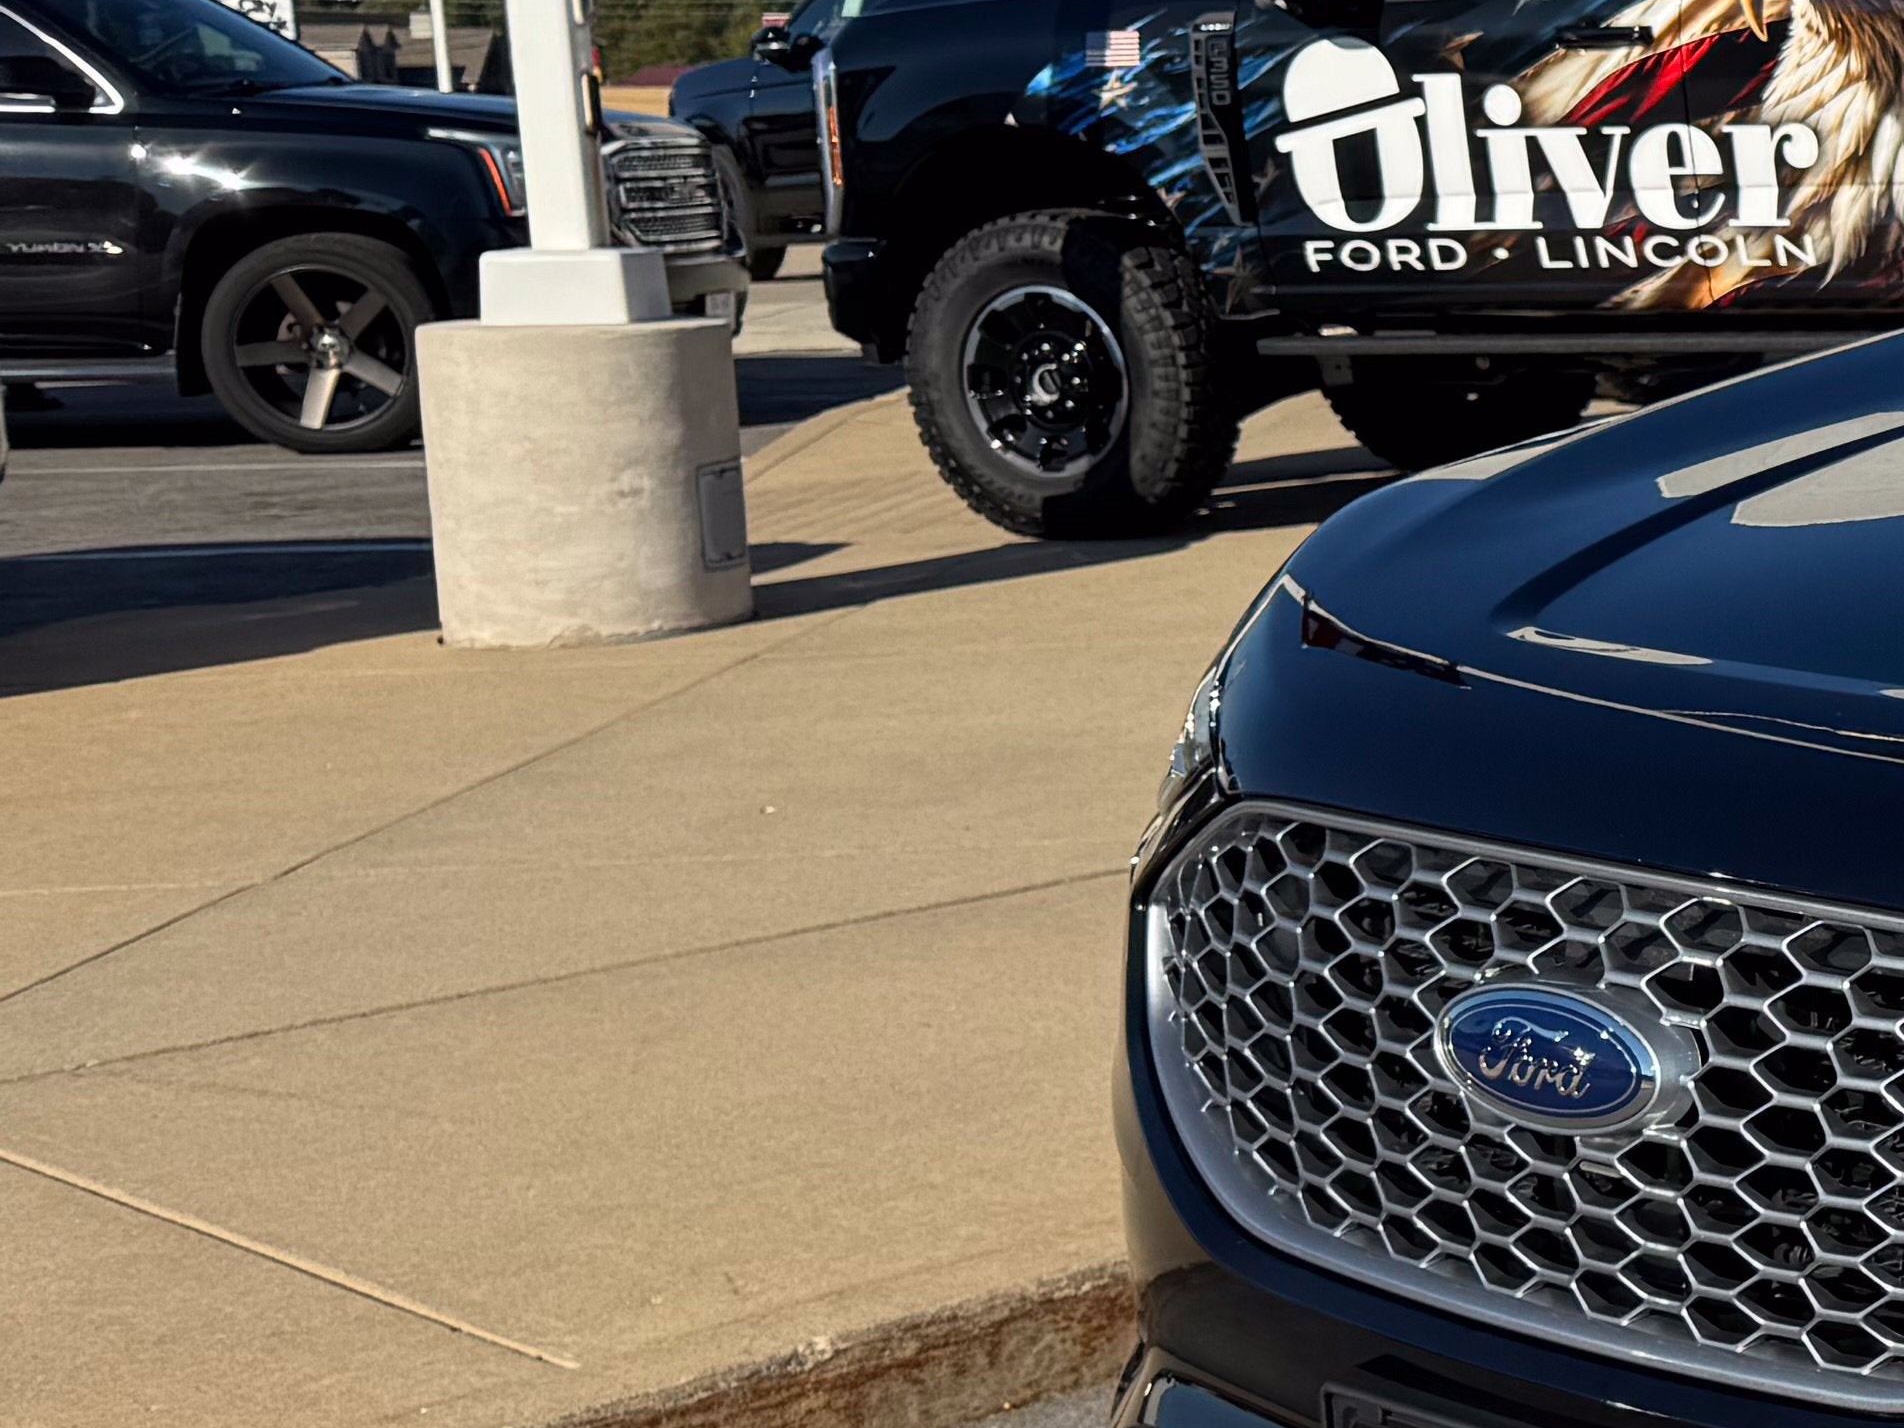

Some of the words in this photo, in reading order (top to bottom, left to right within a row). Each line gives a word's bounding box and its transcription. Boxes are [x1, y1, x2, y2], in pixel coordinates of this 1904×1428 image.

[1275, 35, 1820, 233] Oliver
[1303, 238, 1468, 273] FORD
[1535, 234, 1819, 270] LINCOLN
[1478, 1015, 1597, 1100] Ford
